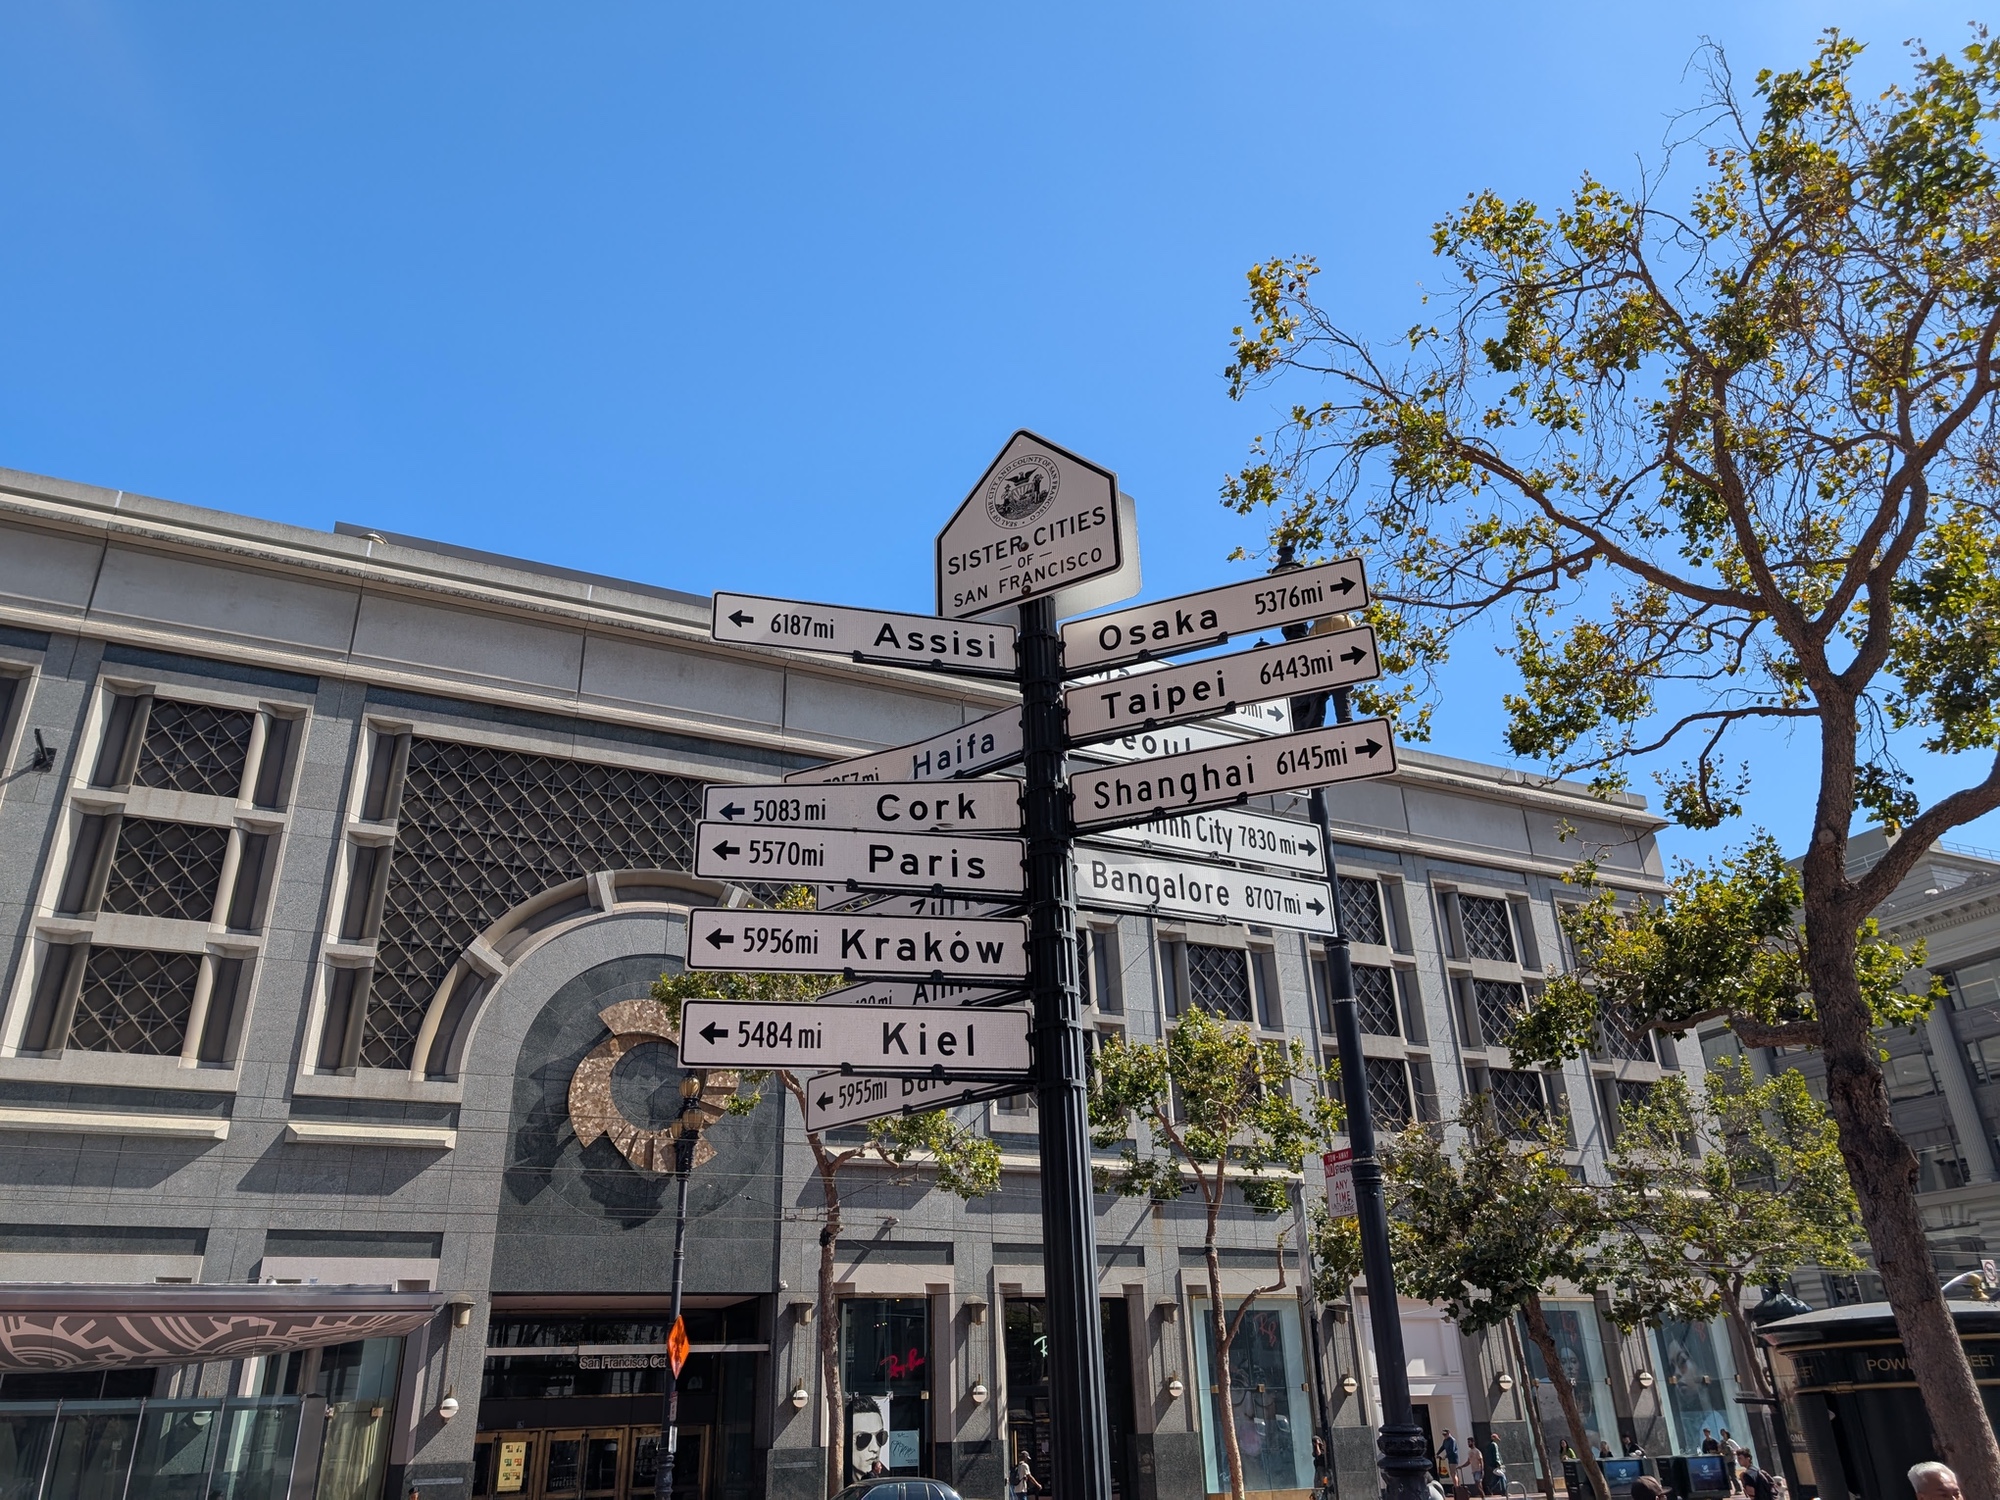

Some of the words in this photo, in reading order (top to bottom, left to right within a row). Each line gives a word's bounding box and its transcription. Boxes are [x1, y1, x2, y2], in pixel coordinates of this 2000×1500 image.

[997, 466, 1012, 480] AND
[1012, 456, 1042, 467] COUNTY
[1042, 458, 1051, 467] OF
[1048, 466, 1058, 480] SAN
[989, 483, 998, 500] CITY
[1029, 480, 1058, 521] FRANCISCO
[1001, 519, 1018, 527] SEAL
[948, 535, 1023, 575] SISTER
[1033, 506, 1106, 546] CITIES
[1017, 553, 1034, 568] OF
[954, 584, 988, 607] SAN
[999, 547, 1102, 593] FRANCISCO
[1099, 608, 1218, 651] Osaka
[1254, 580, 1324, 615] 5376mi
[770, 613, 834, 639] 6187mi
[873, 622, 996, 659] Assisi
[1100, 670, 1226, 719] Taipei
[1260, 649, 1334, 685] 6443mi
[912, 733, 995, 780] Haifa
[1094, 755, 1255, 810] Shanghai
[1276, 740, 1348, 775] 6145mi
[876, 792, 976, 822] Cork
[1196, 815, 1233, 853] City
[749, 840, 824, 867] 5570mi
[868, 844, 985, 879] Paris
[1091, 860, 1230, 907] Bangalore
[1245, 885, 1301, 915] 8707mi
[743, 927, 818, 955] 5956mi
[841, 928, 1004, 964] Kraków
[882, 1021, 975, 1056] Kiel
[838, 1079, 888, 1109] 5955mi
[1325, 1163, 1334, 1176] NO
[1327, 1151, 1349, 1163] TOW-AWAY
[1335, 1180, 1348, 1191] ANY
[1335, 1190, 1351, 1203] TIME
[579, 1356, 600, 1369] San
[601, 1355, 649, 1369] Francisco
[650, 1355, 666, 1369] Ce
[1866, 1357, 1911, 1371] POW
